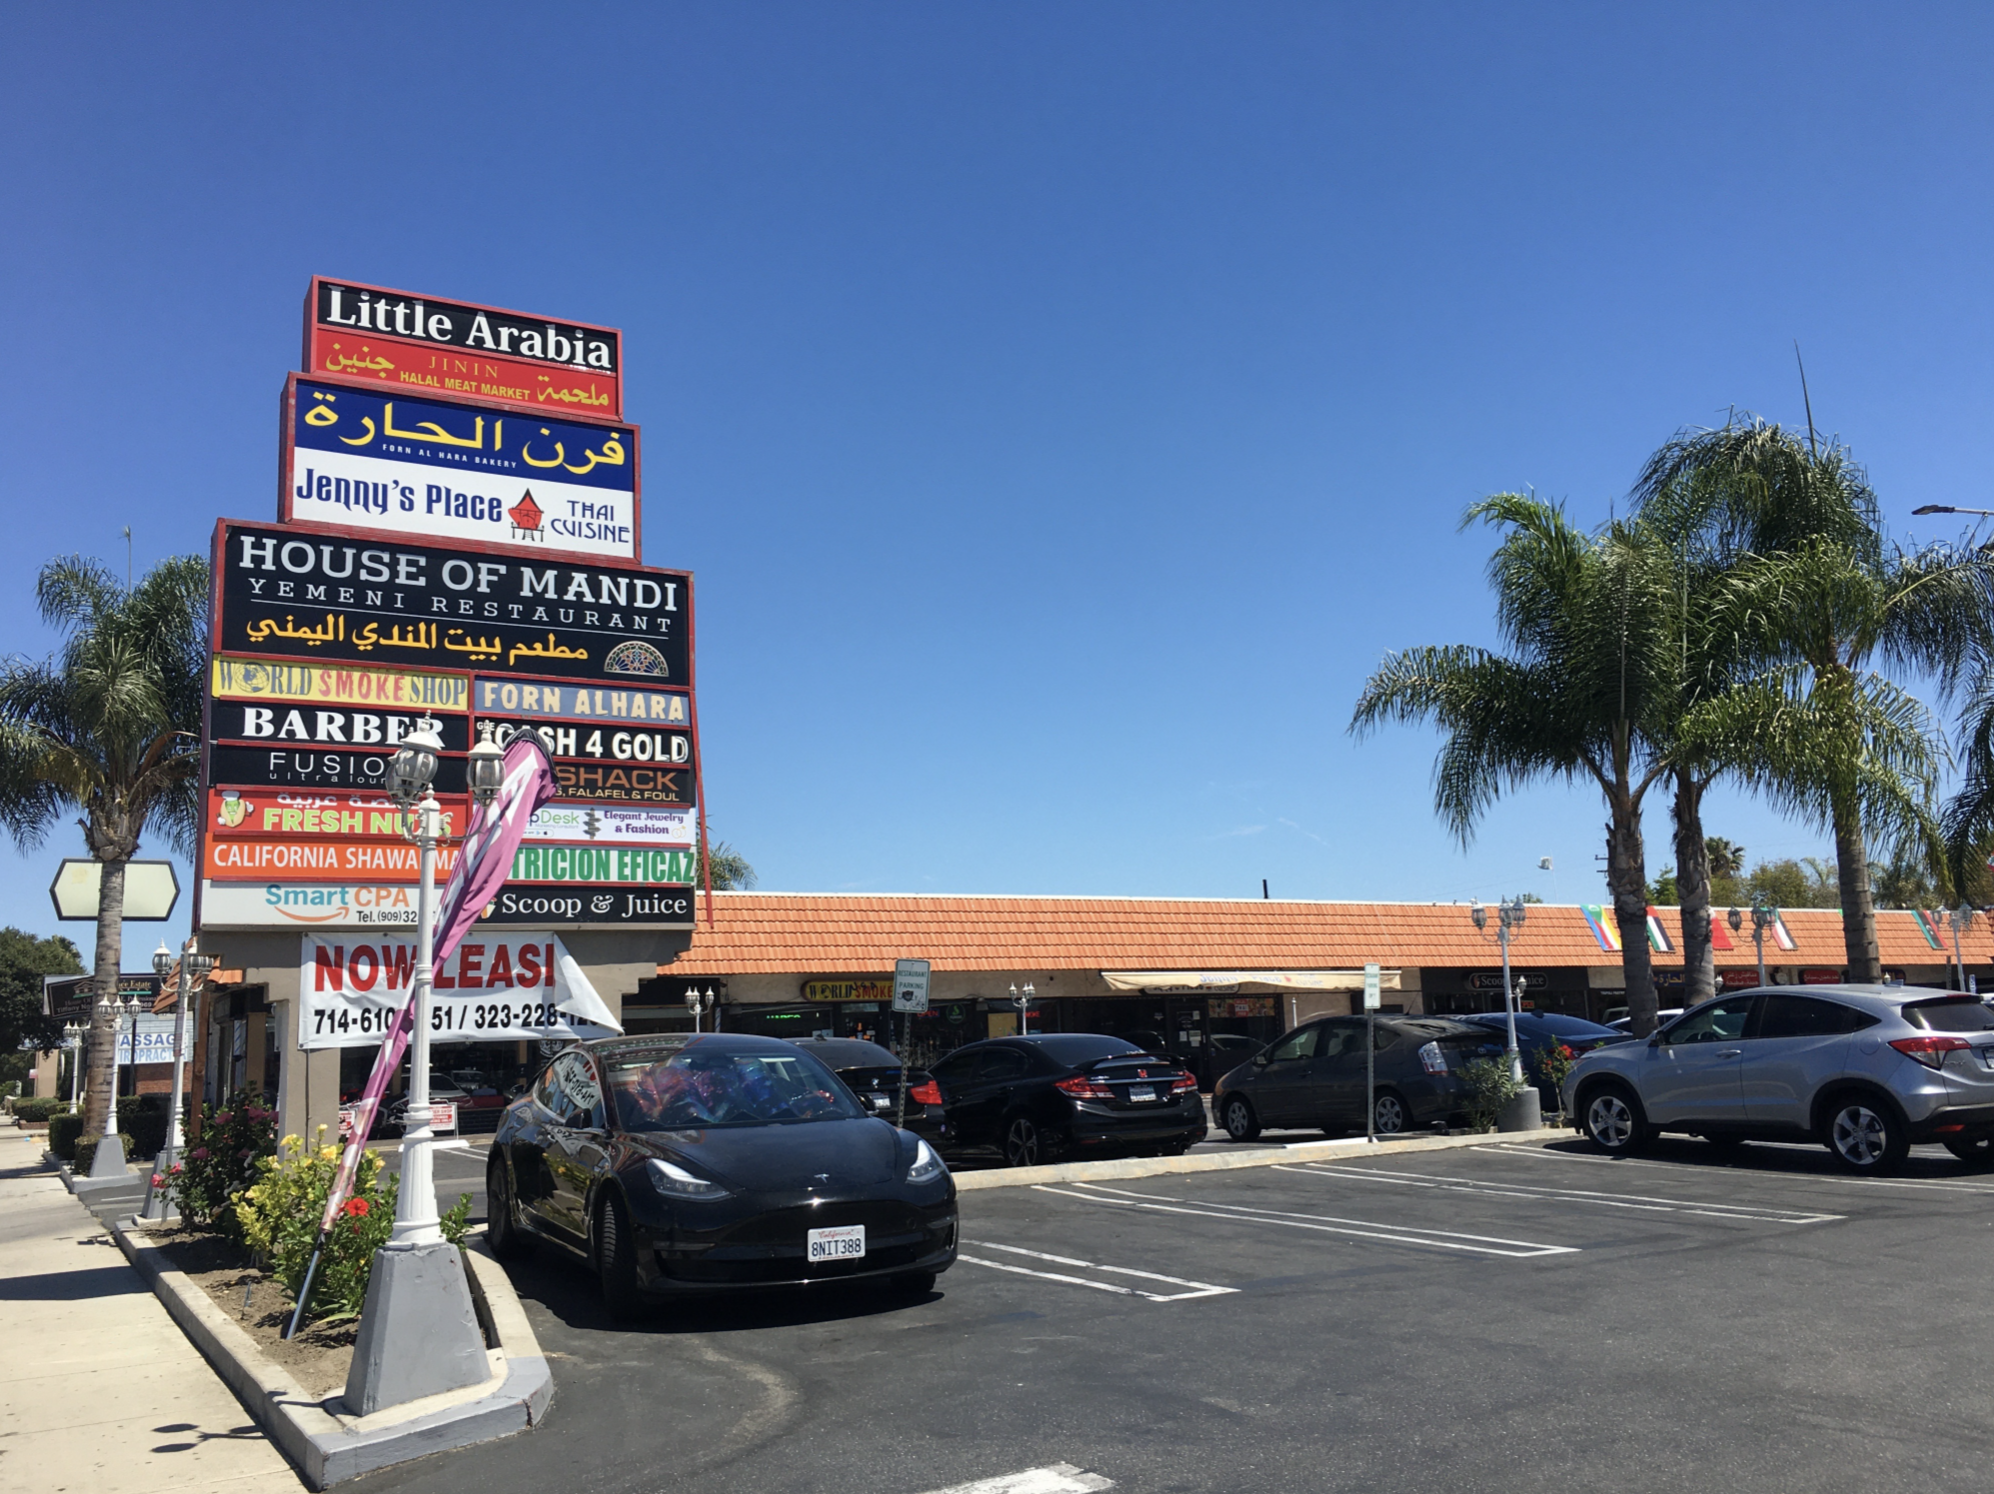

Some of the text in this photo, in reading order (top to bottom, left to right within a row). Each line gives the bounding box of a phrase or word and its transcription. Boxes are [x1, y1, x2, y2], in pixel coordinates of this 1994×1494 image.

[327, 285, 612, 368] Little Arabia
[325, 343, 395, 379] جنين
[428, 355, 499, 378] JININ
[400, 370, 531, 400] HALAL MEAT MARKET
[536, 376, 610, 406] ملحمة
[304, 391, 626, 475] فرن الحارة
[382, 443, 517, 469] FORN AL HARA BAKERY
[296, 468, 503, 523] Jenny's Place
[566, 500, 615, 522] THAI
[550, 518, 630, 544] CUISINE
[239, 535, 678, 612] HOUSE OF MANDI
[250, 578, 672, 633] YEMENI RESTAURANT
[246, 613, 589, 666] مطعم بيت المندي اليمني
[318, 668, 405, 702] SMOKE
[409, 674, 467, 706] SHOP
[483, 682, 561, 714] FORN
[585, 730, 604, 758] 4
[612, 731, 689, 764] GOLD
[269, 772, 339, 783] ultra
[555, 766, 679, 791] SHACK
[568, 788, 629, 800] FALAFEL
[631, 790, 643, 799] &
[644, 791, 680, 802] FOUL
[263, 808, 364, 833] FRESH
[604, 810, 684, 824] Elegant Jewelry
[614, 823, 670, 834] & Fashion
[213, 844, 339, 869] CALIFORNIA
[617, 850, 695, 883] EFICAZ
[265, 884, 411, 908] Smart CPA
[501, 893, 688, 918] Scoop & Juice
[356, 910, 376, 923] Tel.
[314, 944, 418, 992] NOW
[898, 970, 927, 978] RESTAURANT
[1481, 975, 1504, 986] Scoo
[130, 980, 152, 988] Estate
[899, 981, 925, 990] PARKING
[811, 1237, 862, 1257] 8NIT388
[819, 1230, 855, 1240] California
